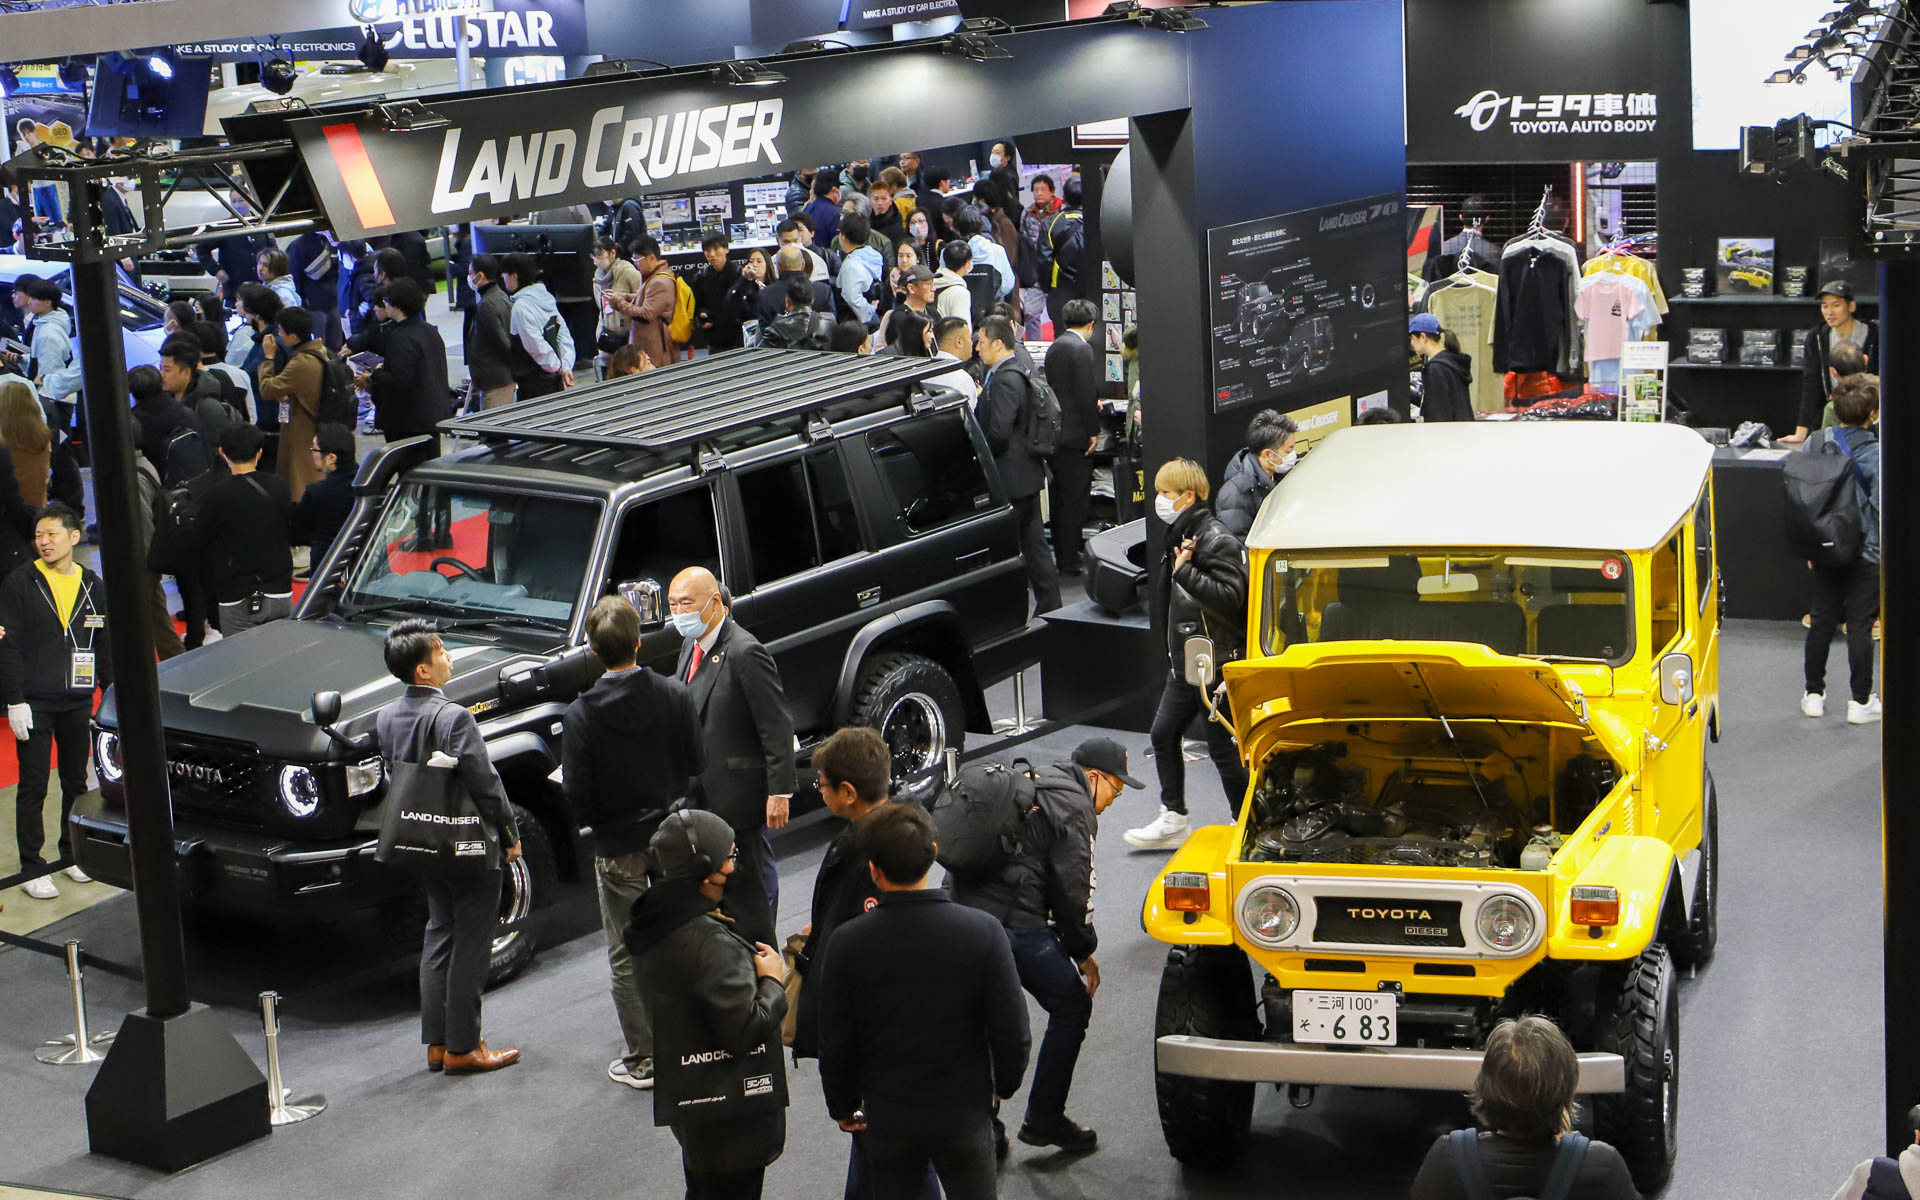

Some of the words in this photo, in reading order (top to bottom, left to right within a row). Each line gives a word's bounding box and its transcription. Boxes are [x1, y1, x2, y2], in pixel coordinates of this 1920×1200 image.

[863, 10, 881, 19] MAKE
[888, 6, 907, 16] STUDY
[907, 5, 915, 13] OF
[916, 3, 929, 11] CAR
[194, 44, 203, 53] A
[204, 44, 239, 53] STUDY
[240, 43, 256, 53] OF
[1510, 93, 1657, 118] トヨタ車体
[1510, 120, 1568, 133] TOYOTA
[1570, 120, 1613, 133] AUTO
[1614, 119, 1657, 132] BODY
[431, 128, 577, 214] LAND
[582, 98, 784, 188] CRUISER
[167, 761, 223, 783] TOYOTA
[401, 811, 432, 822] LAND
[433, 815, 480, 825] CRUISER
[1347, 908, 1432, 920] TOYOTA
[1405, 926, 1449, 937] DIESEL
[681, 1052, 712, 1066] LAND
